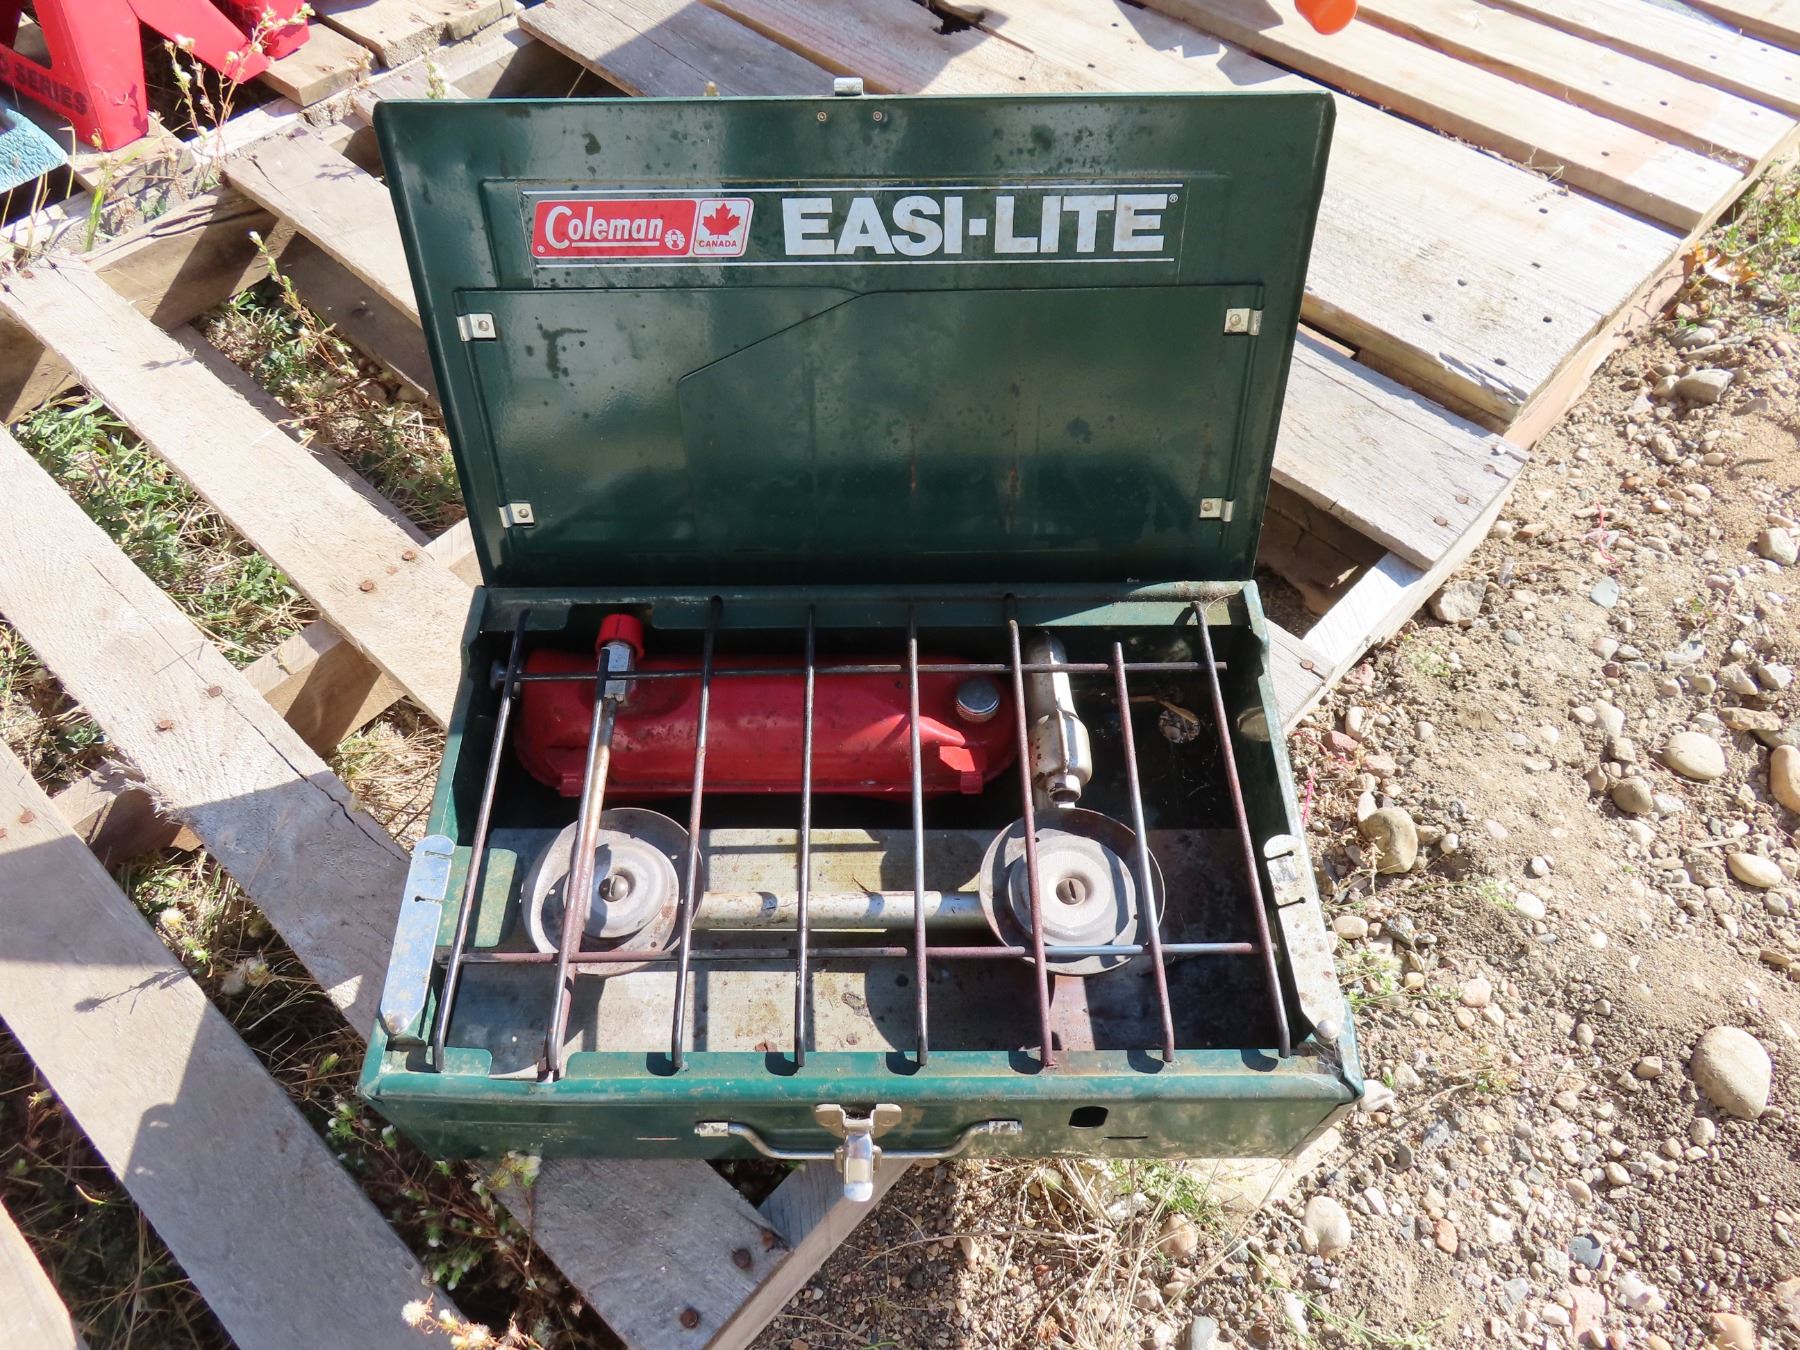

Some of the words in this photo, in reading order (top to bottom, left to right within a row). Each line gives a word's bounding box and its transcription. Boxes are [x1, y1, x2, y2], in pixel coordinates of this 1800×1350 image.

[15, 61, 88, 115] SERIES
[545, 205, 663, 249] Coleman
[698, 239, 737, 248] CANADA
